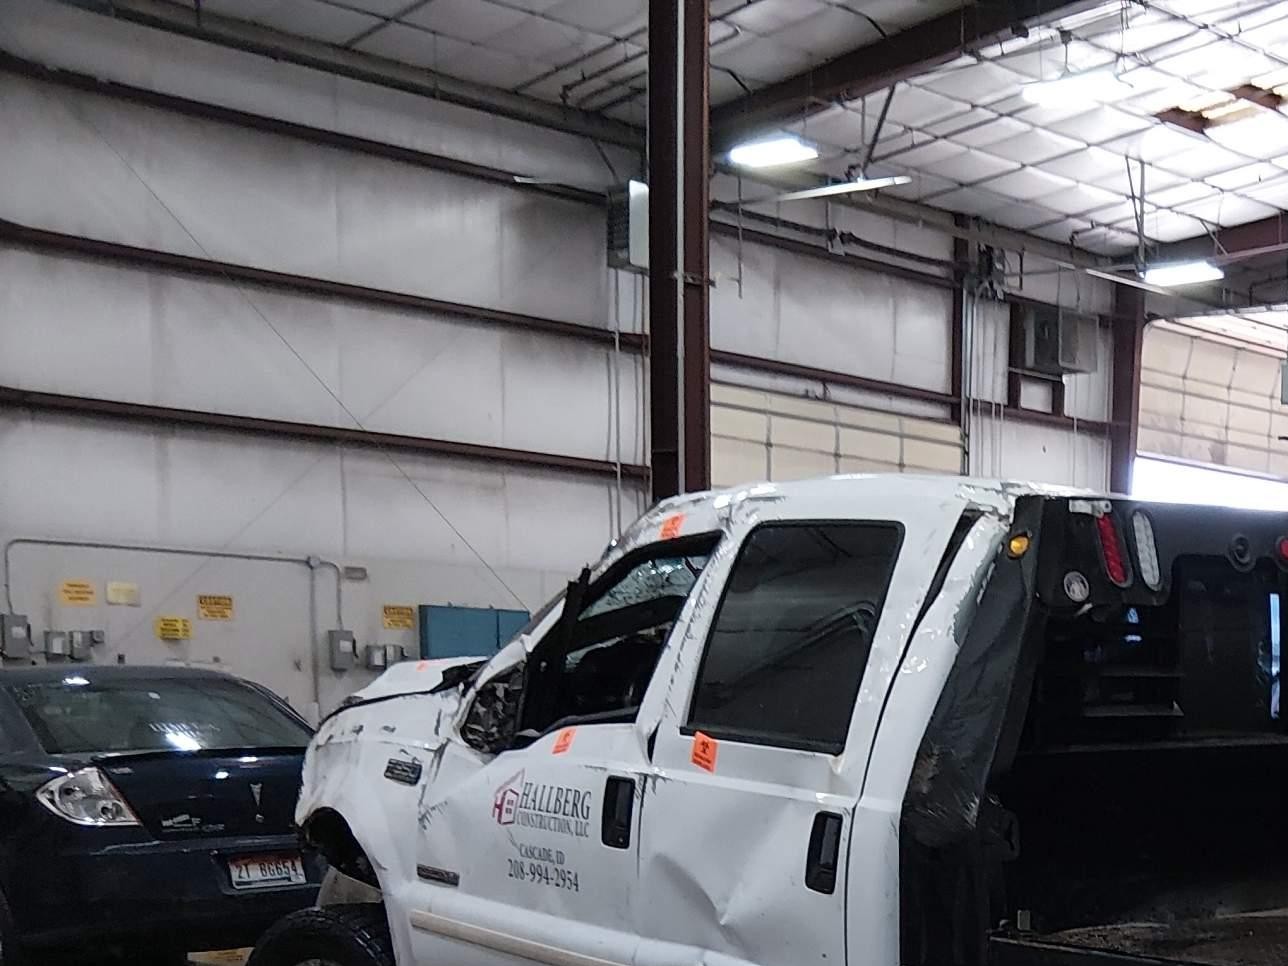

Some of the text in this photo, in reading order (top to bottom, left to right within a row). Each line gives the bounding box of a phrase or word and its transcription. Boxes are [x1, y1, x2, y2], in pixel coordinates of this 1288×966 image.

[519, 782, 592, 820] HALLBERG
[575, 820, 590, 838] LLC
[556, 850, 565, 865] ID
[508, 858, 579, 892] 208-994-2954
